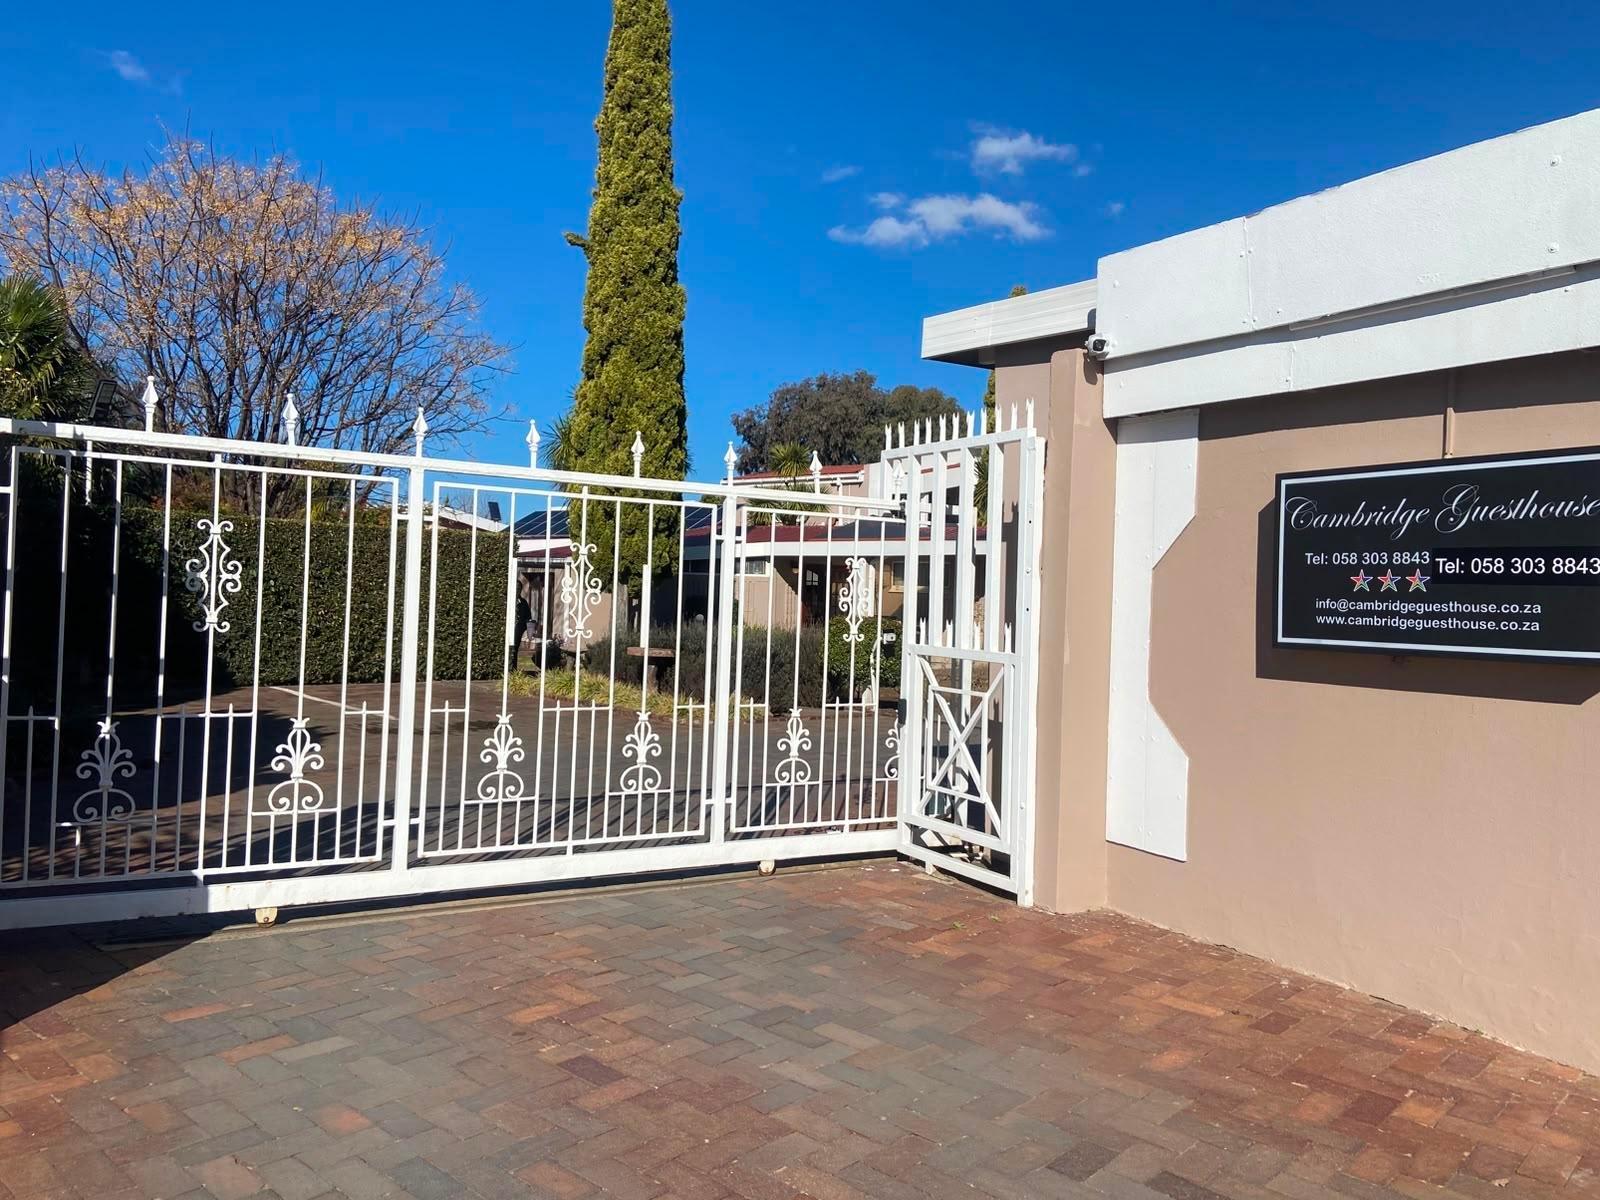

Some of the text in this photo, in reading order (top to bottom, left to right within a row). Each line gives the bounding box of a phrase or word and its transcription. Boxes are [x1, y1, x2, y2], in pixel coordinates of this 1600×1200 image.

[1285, 483, 1600, 540] Cambridge Guesthouse
[1305, 551, 1430, 565] Tel: 058 303 8843
[1435, 558, 1600, 575] Tel: 058 303 8843
[1315, 598, 1541, 614] info@cambridgeguesthouse.co.za
[1315, 614, 1540, 631] www.cambridgeguesthouse.co.za
